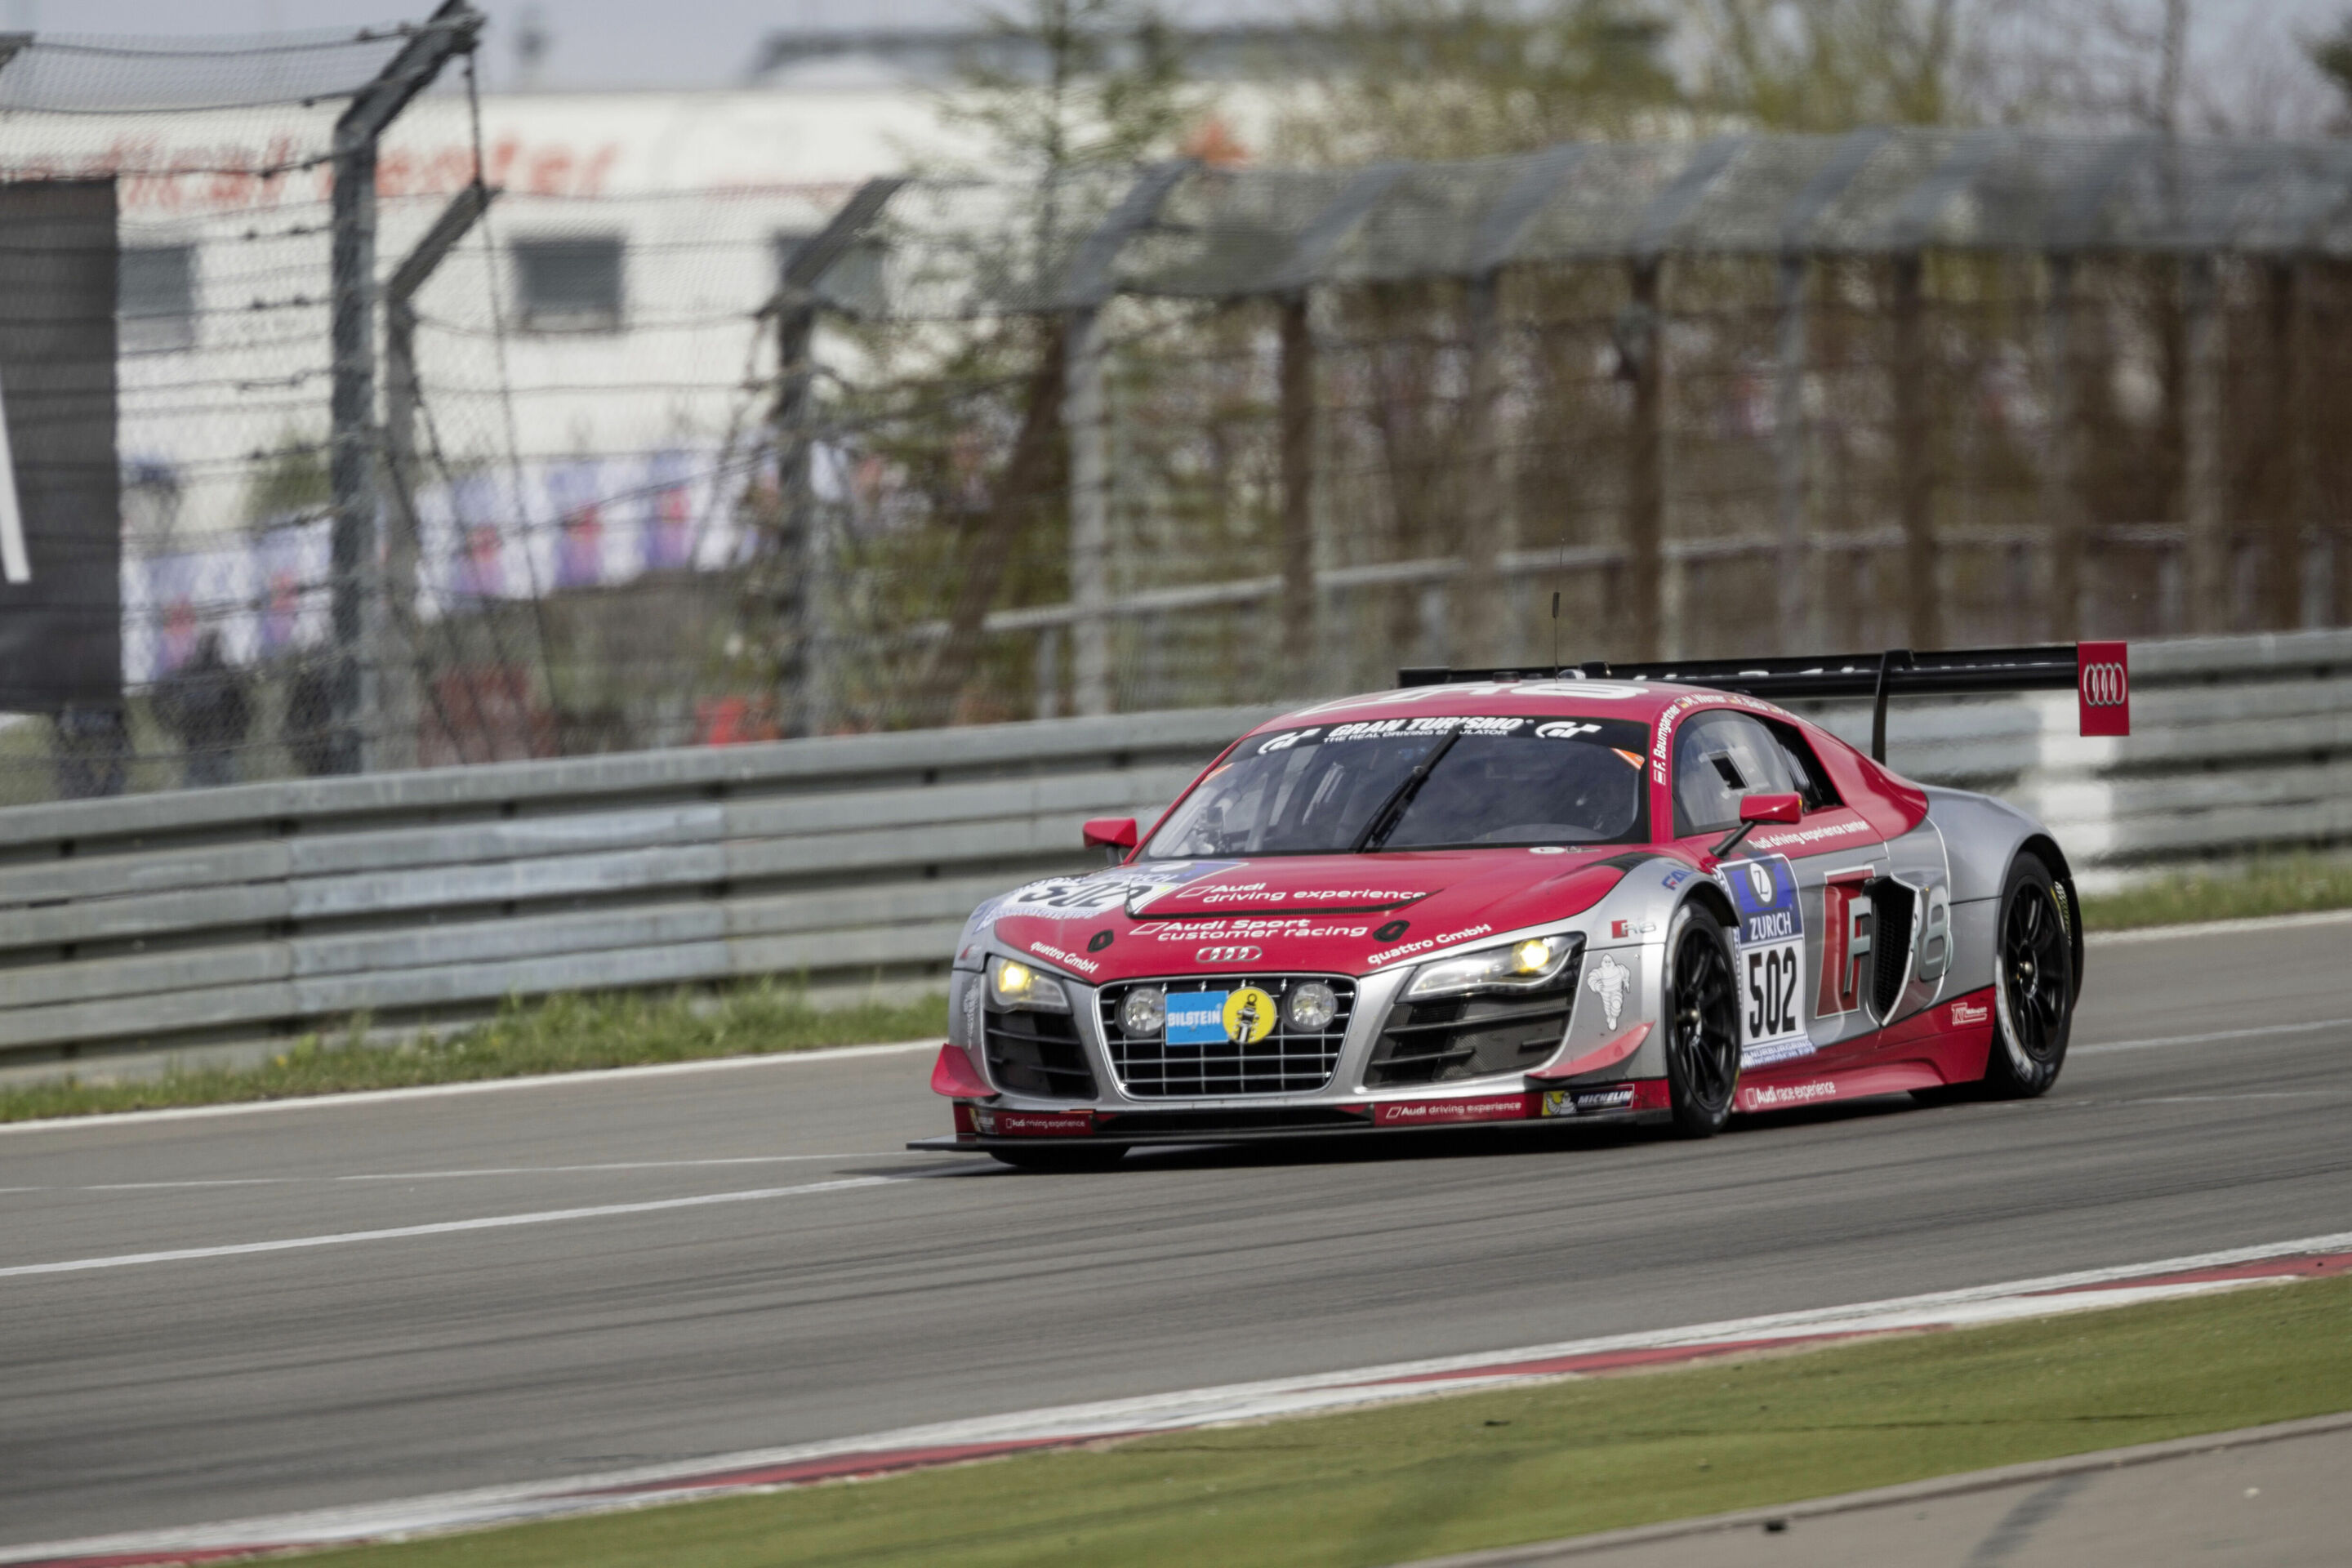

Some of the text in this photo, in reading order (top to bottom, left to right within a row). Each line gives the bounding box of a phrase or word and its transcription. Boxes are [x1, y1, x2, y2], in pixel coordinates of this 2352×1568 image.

[1324, 728, 1509, 744] THE REAL DRIVING SIULATOR
[1328, 716, 1525, 737] GRAN TURISMO
[1653, 705, 1681, 761] Baumgartner
[1769, 832, 1806, 847] driving
[1798, 825, 1846, 842] experience
[1203, 889, 1427, 903] driving experience
[1209, 883, 1266, 893] Audi
[1157, 925, 1369, 941] customer racing
[1164, 919, 1311, 931] Audi Sport
[1749, 911, 1793, 941] ZURICH
[1367, 923, 1493, 965] quattro GmbH
[1030, 941, 1100, 974] quattro GmbH
[1748, 946, 1797, 1039] 502
[1167, 1009, 1221, 1027] BILSTEIN
[1578, 1090, 1633, 1105] MICHELIN
[1756, 1080, 1836, 1103] Audi race experience
[1401, 1101, 1521, 1116] Audi driving experience
